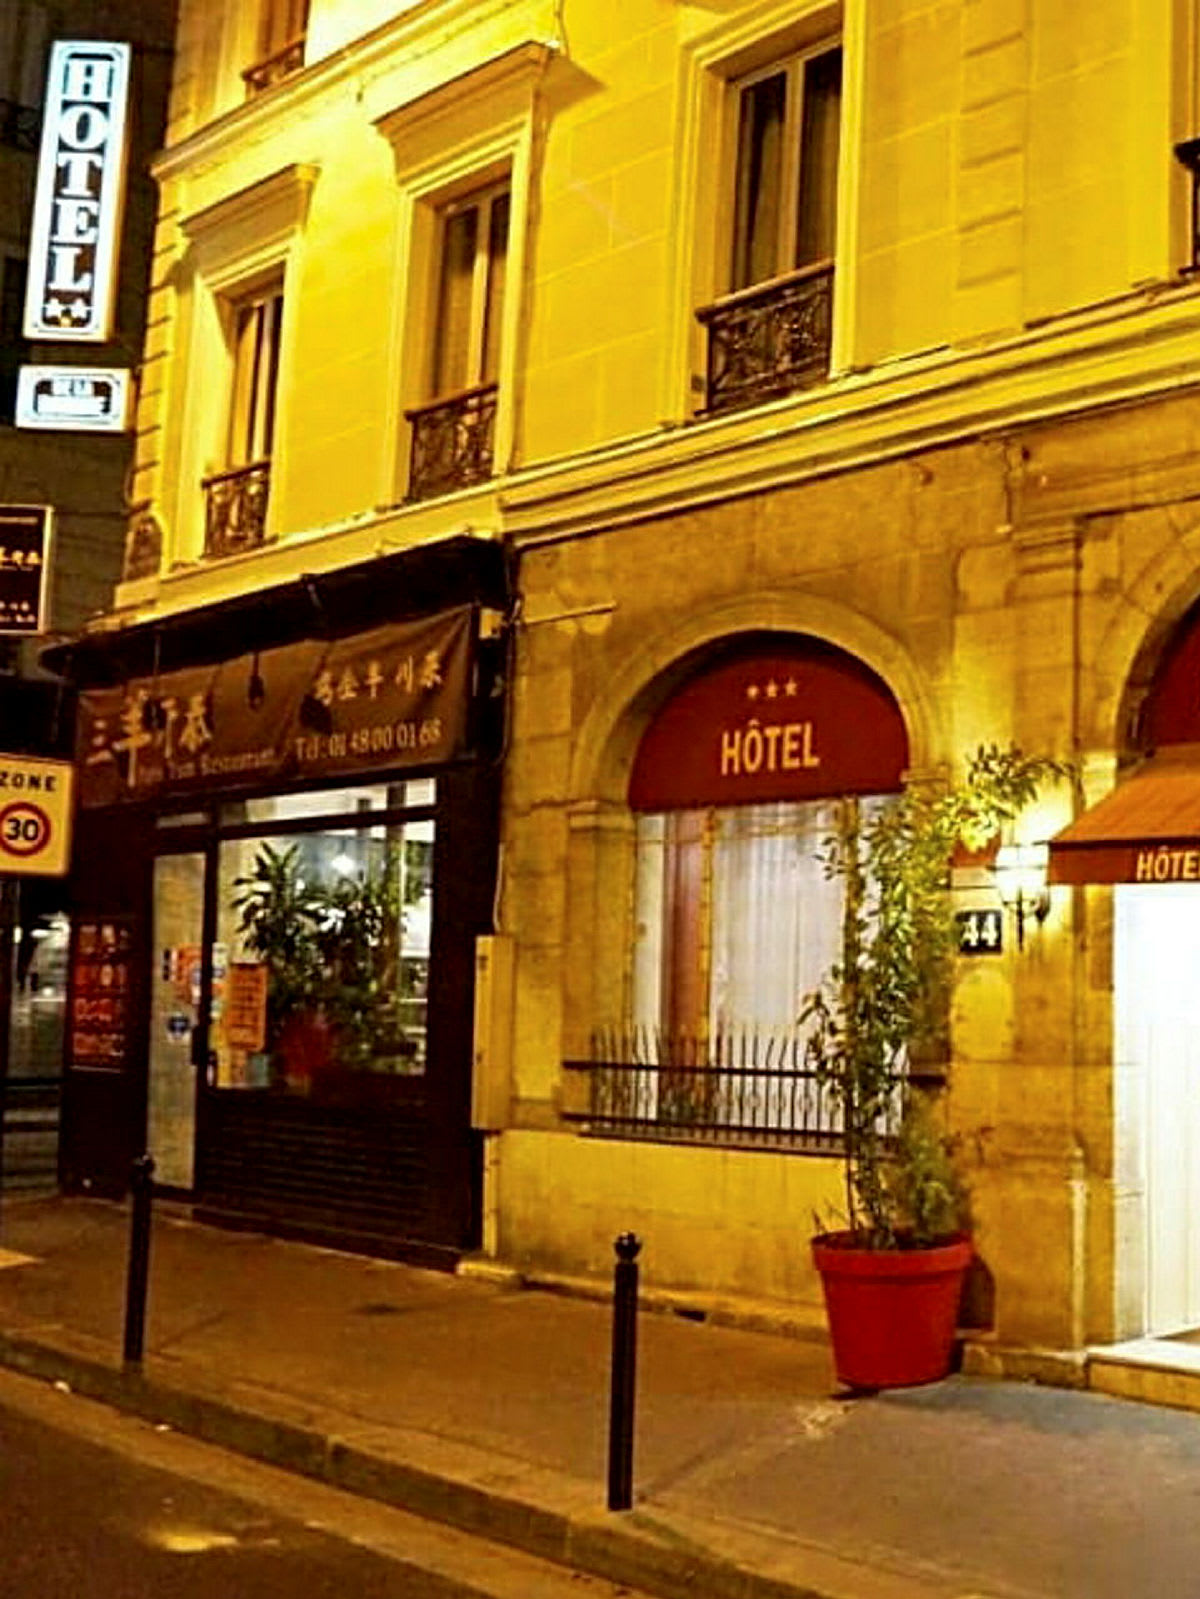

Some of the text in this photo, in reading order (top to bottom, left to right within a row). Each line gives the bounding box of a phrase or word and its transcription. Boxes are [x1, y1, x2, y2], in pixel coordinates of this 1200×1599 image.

[48, 57, 112, 292] HOTEL
[721, 717, 821, 776] HÔTEL
[0, 771, 57, 792] ZONE
[6, 817, 39, 841] 30
[962, 913, 998, 947] 44
